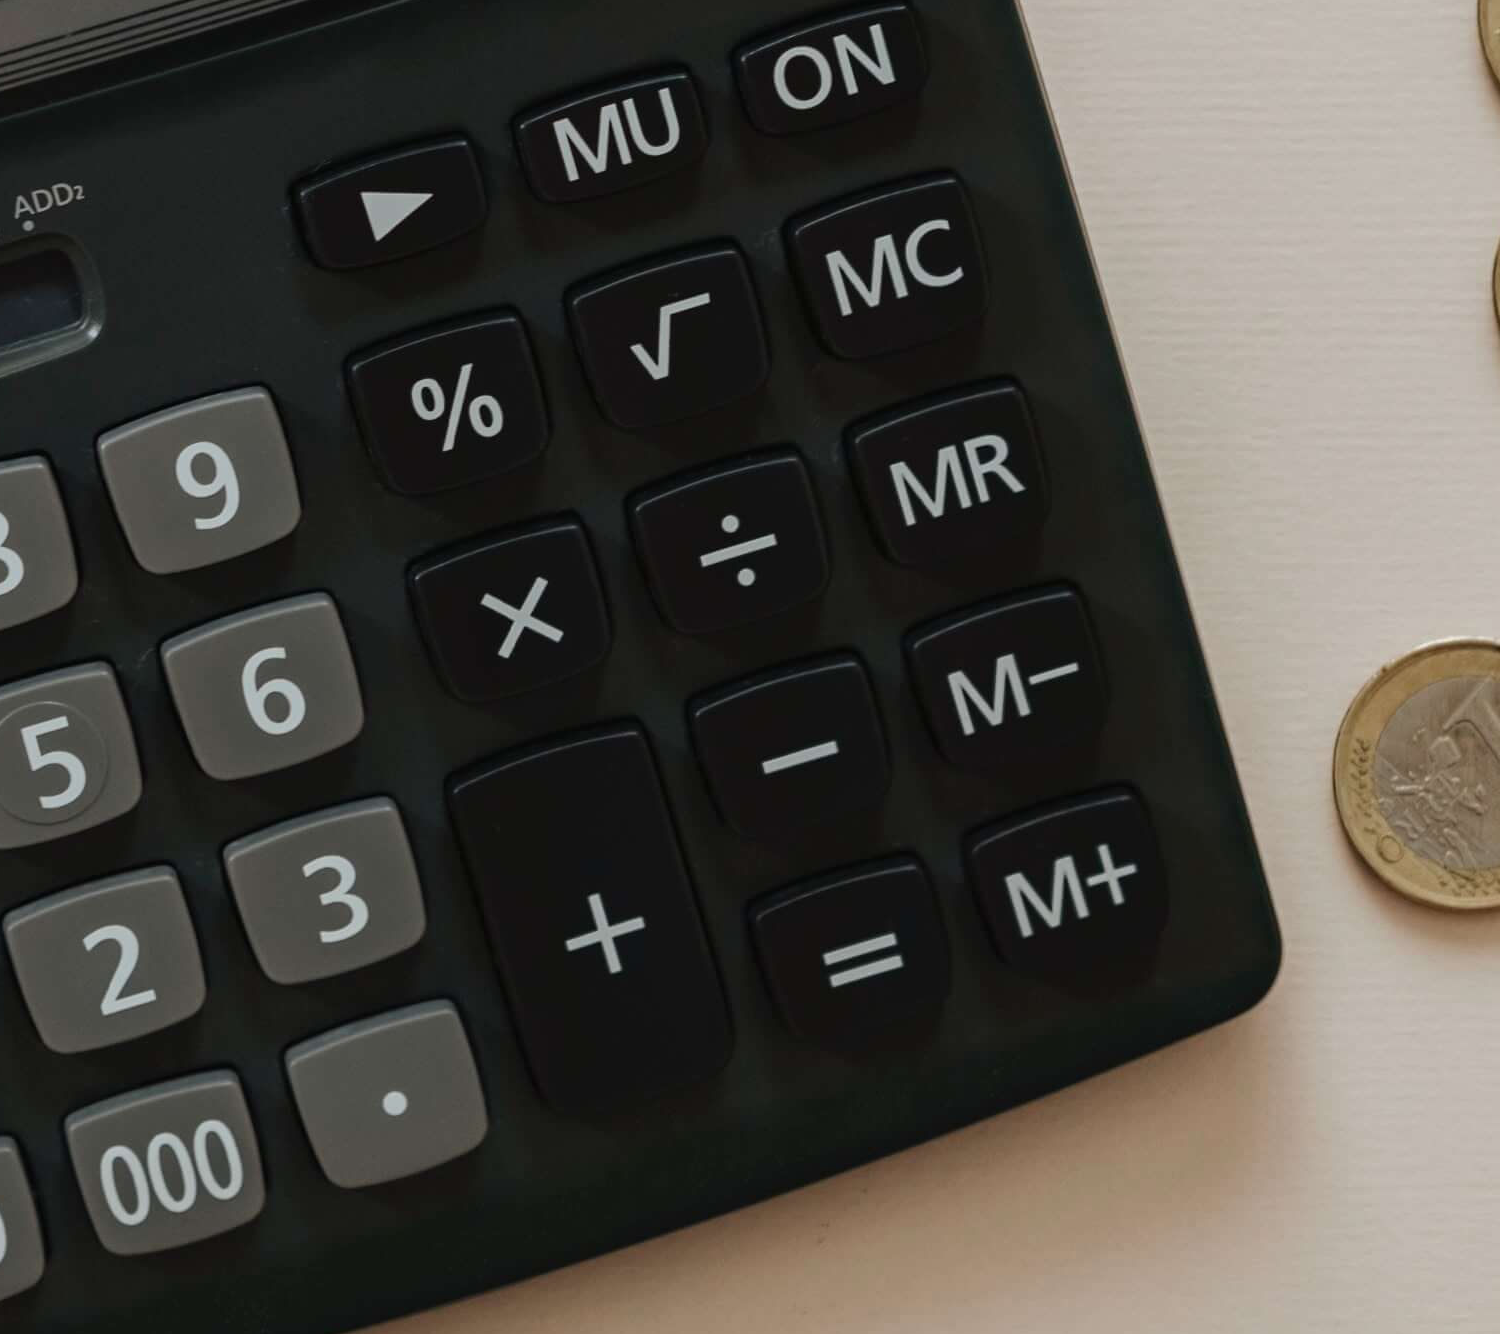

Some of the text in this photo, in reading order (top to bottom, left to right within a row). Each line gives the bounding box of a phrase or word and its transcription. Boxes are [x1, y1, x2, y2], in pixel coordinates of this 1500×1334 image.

[773, 23, 896, 110] ON
[552, 87, 680, 182] MU
[825, 219, 964, 316] MC
[411, 362, 504, 452] %
[175, 441, 240, 530] 9
[889, 434, 1026, 526] MR
[241, 646, 306, 735] 6
[20, 715, 87, 809] 5
[302, 854, 369, 943] 3
[1005, 844, 1137, 938] M+
[82, 924, 157, 1016] 2
[100, 1119, 243, 1226] 000
